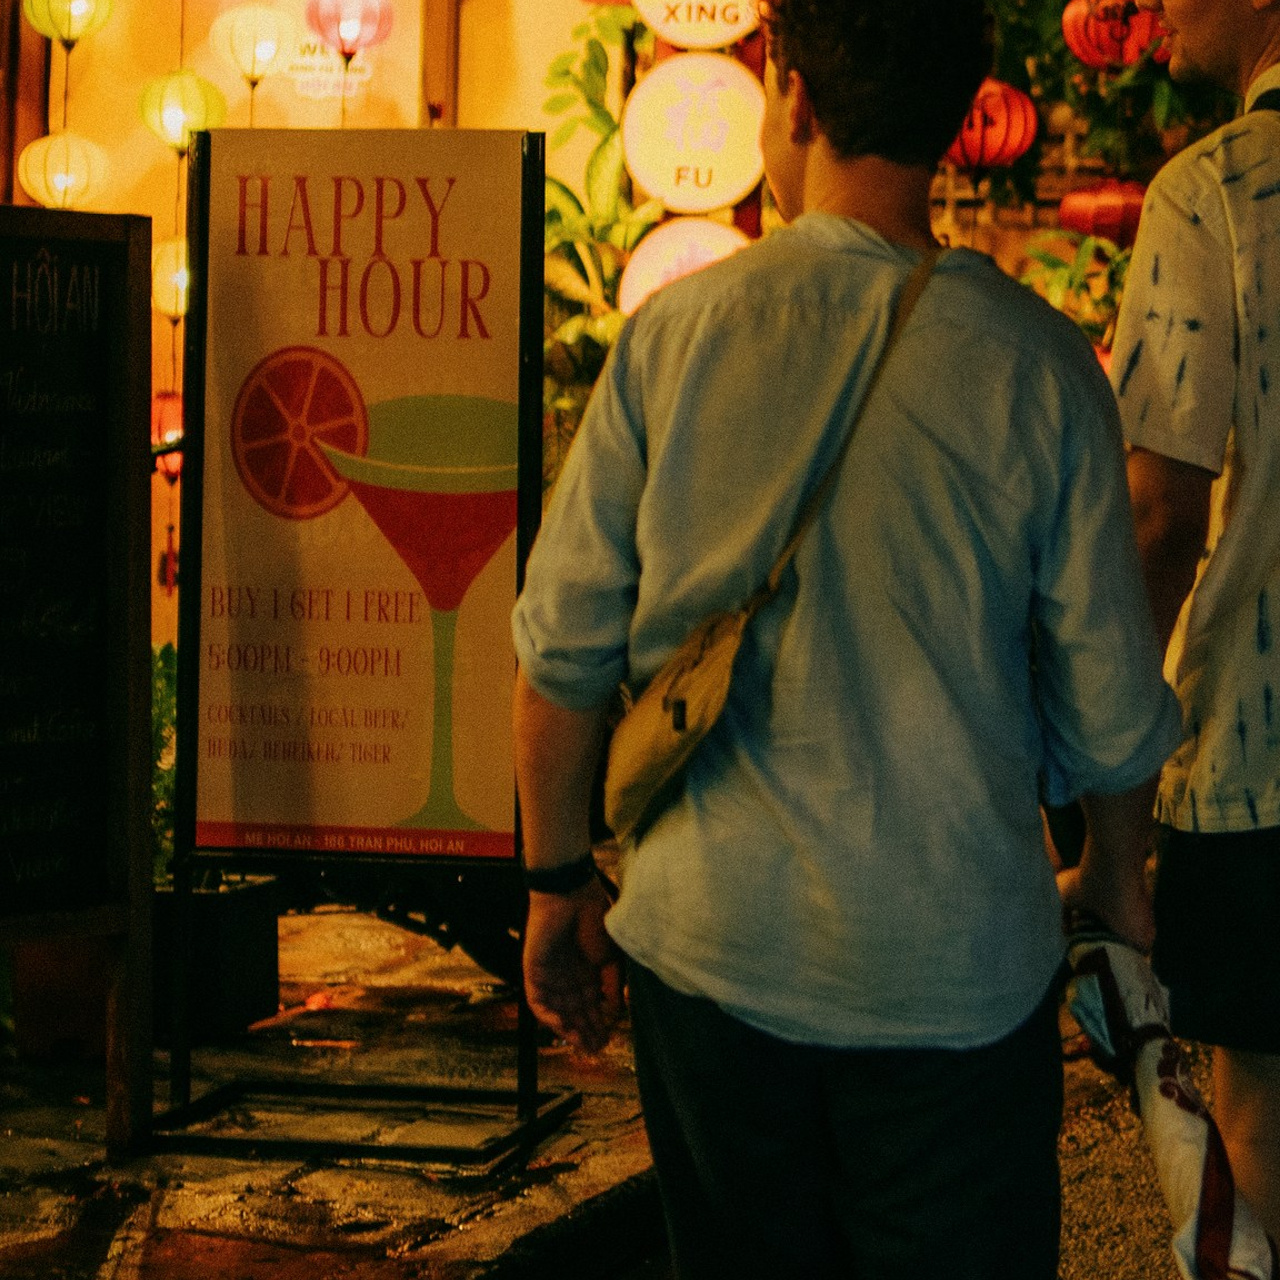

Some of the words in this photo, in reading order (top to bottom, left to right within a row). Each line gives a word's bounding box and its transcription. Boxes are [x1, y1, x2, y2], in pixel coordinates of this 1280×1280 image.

[663, 2, 741, 25] XING
[675, 166, 713, 189] FU
[235, 175, 456, 257] HAPPY
[62, 263, 100, 333] AN
[316, 258, 491, 339] HOUR
[211, 587, 259, 619] BUY
[290, 588, 334, 621] GET
[363, 590, 421, 624] FREE
[208, 643, 292, 673] 5:00PM
[318, 646, 402, 677] 9:00PM
[207, 704, 290, 726] COCKTAILS
[310, 706, 357, 728] LOCAL
[350, 743, 391, 765] TIGER
[446, 840, 465, 855] AN
